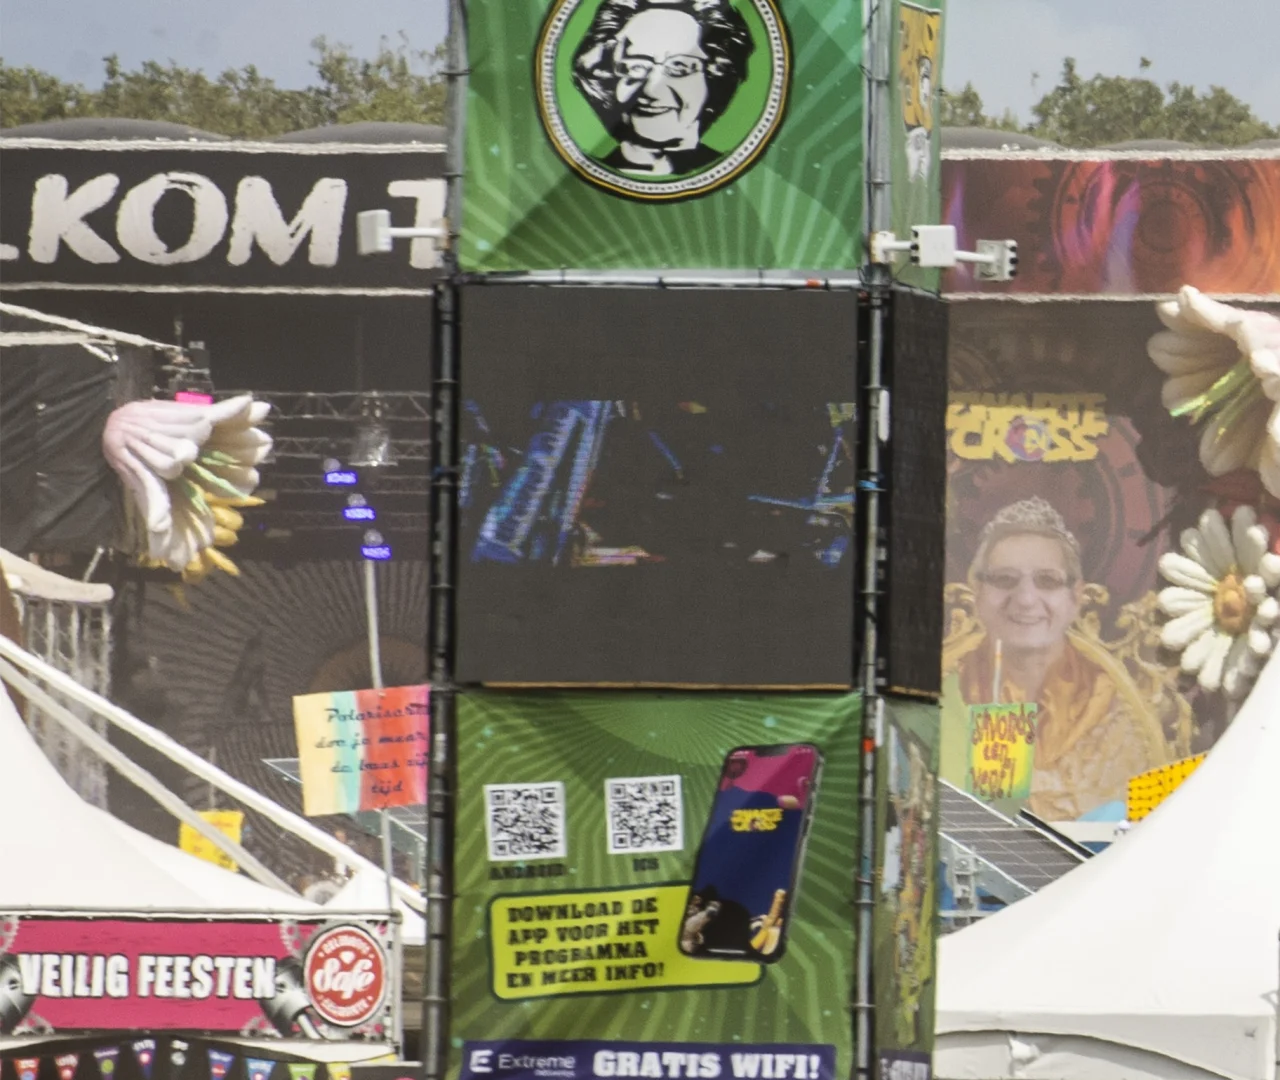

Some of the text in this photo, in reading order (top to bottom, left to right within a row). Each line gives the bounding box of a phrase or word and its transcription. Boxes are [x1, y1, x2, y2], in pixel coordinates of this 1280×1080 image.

[0, 172, 348, 267] KOM
[507, 898, 658, 922] DOWNLOAD DE
[507, 919, 660, 945] APP VOOR HET
[515, 942, 649, 966] PROGRAMMA
[18, 953, 276, 1000] VEILIG FEESTEN
[313, 957, 375, 999] Safe
[507, 963, 665, 988] EN MEER INFO!
[498, 1053, 576, 1070] Extreme
[593, 1050, 820, 1080] GRATIS WIFI!
